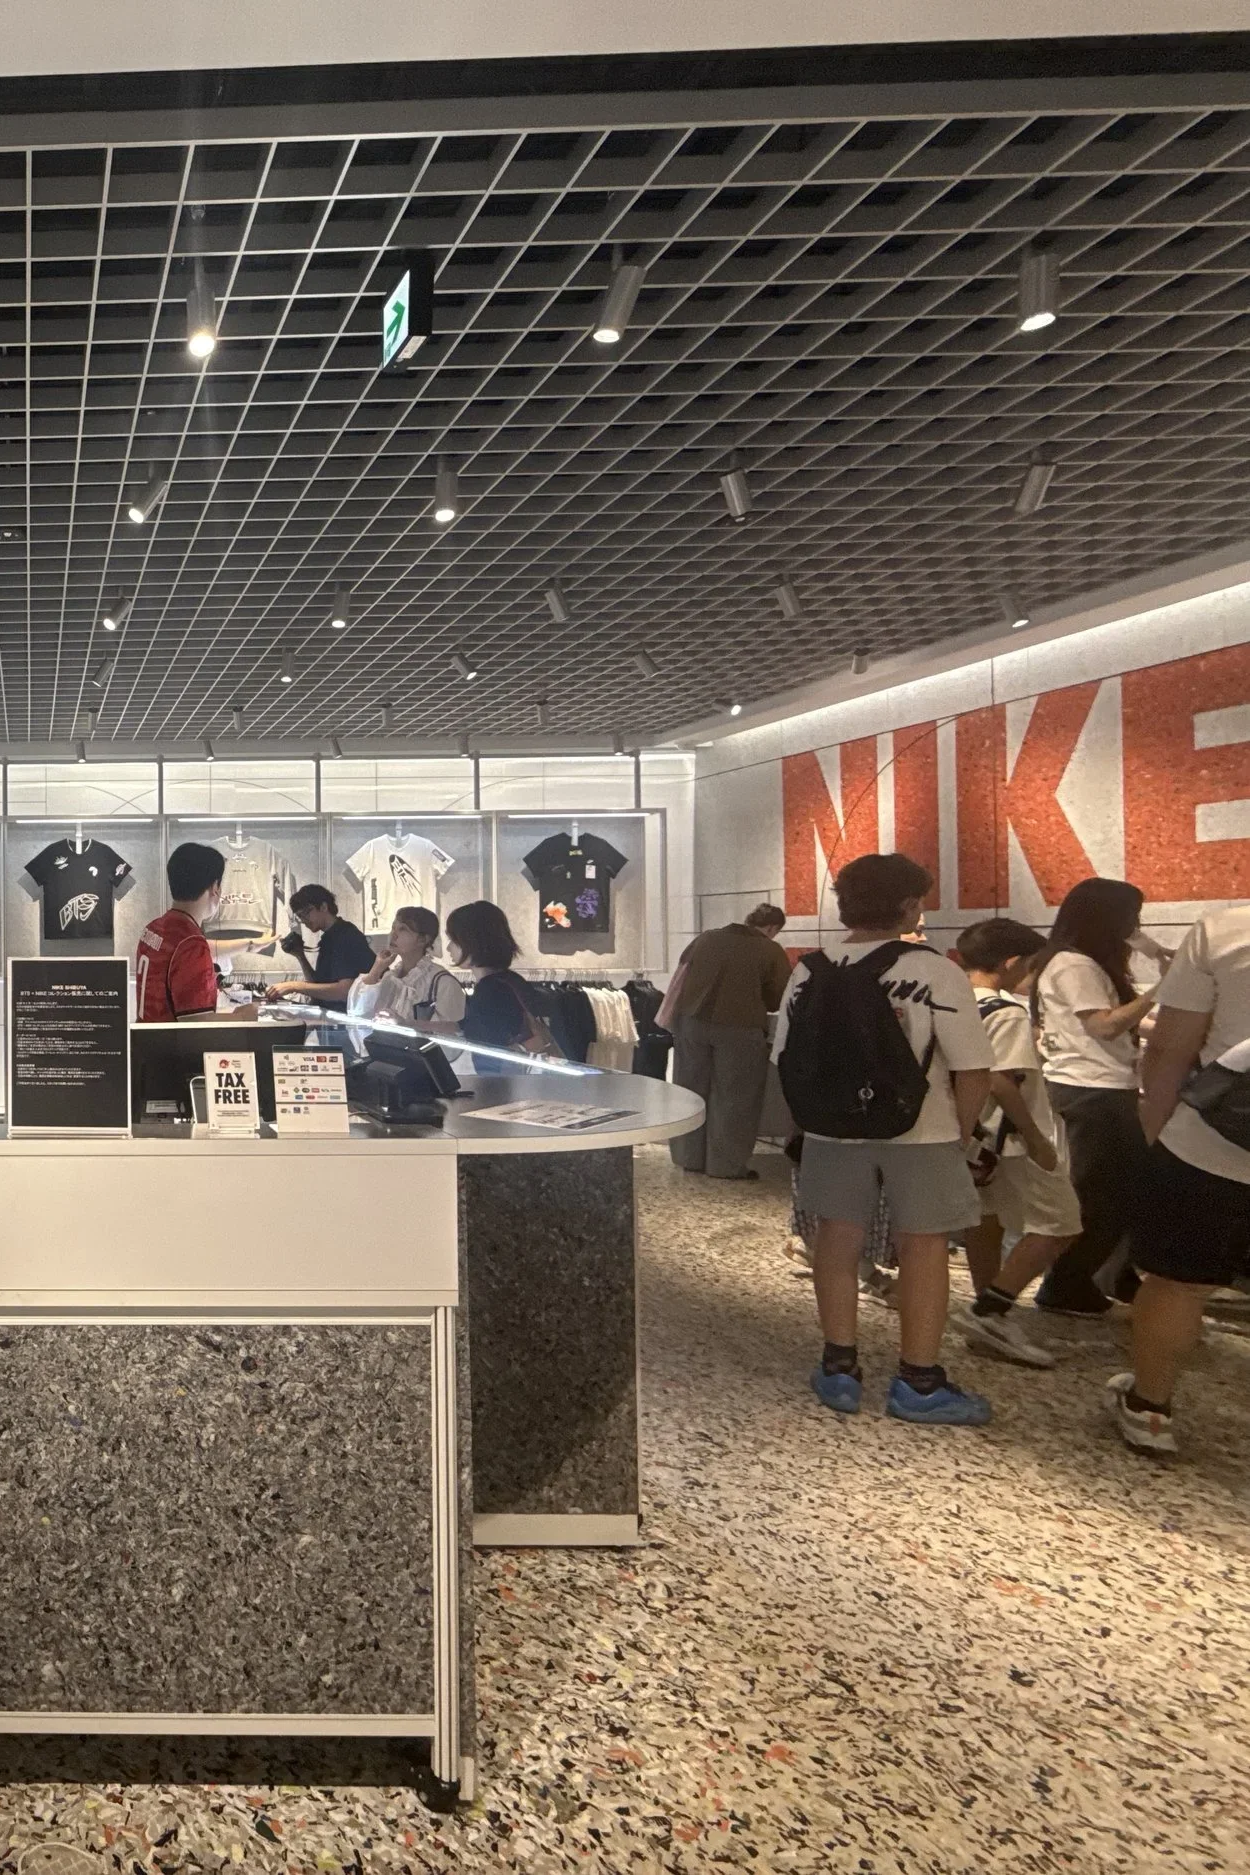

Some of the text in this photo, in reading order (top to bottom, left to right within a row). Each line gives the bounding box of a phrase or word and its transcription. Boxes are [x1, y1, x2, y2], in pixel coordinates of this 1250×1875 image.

[782, 642, 1250, 916] NIKE
[216, 1073, 246, 1088] TAX
[214, 1089, 250, 1104] FREE
